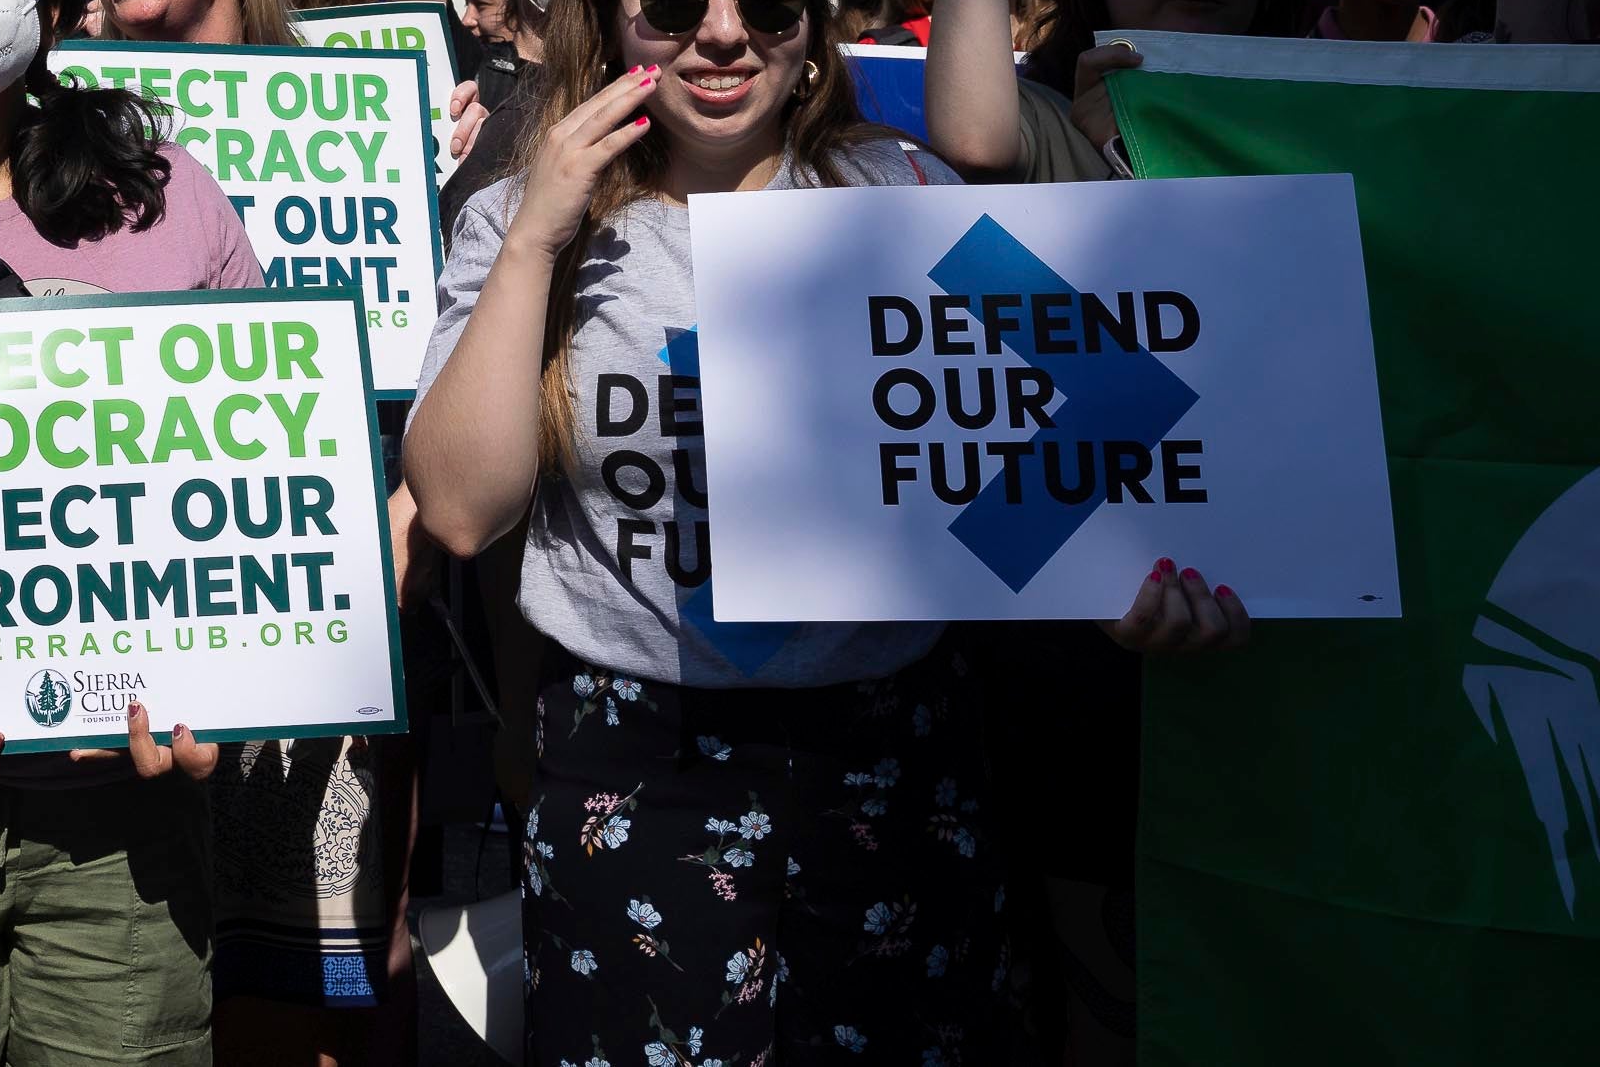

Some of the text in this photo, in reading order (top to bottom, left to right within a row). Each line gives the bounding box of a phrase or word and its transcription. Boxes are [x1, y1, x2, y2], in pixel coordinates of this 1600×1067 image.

[266, 71, 391, 122] OUR
[274, 195, 401, 245] OUR
[158, 321, 323, 387] OUR
[868, 290, 1201, 358] DEFEND
[872, 366, 1057, 432] OUR
[879, 440, 1208, 506] FUTURE
[171, 475, 339, 542] OUR
[73, 670, 147, 692] SIERRA
[82, 715, 123, 723] FOUNDED
